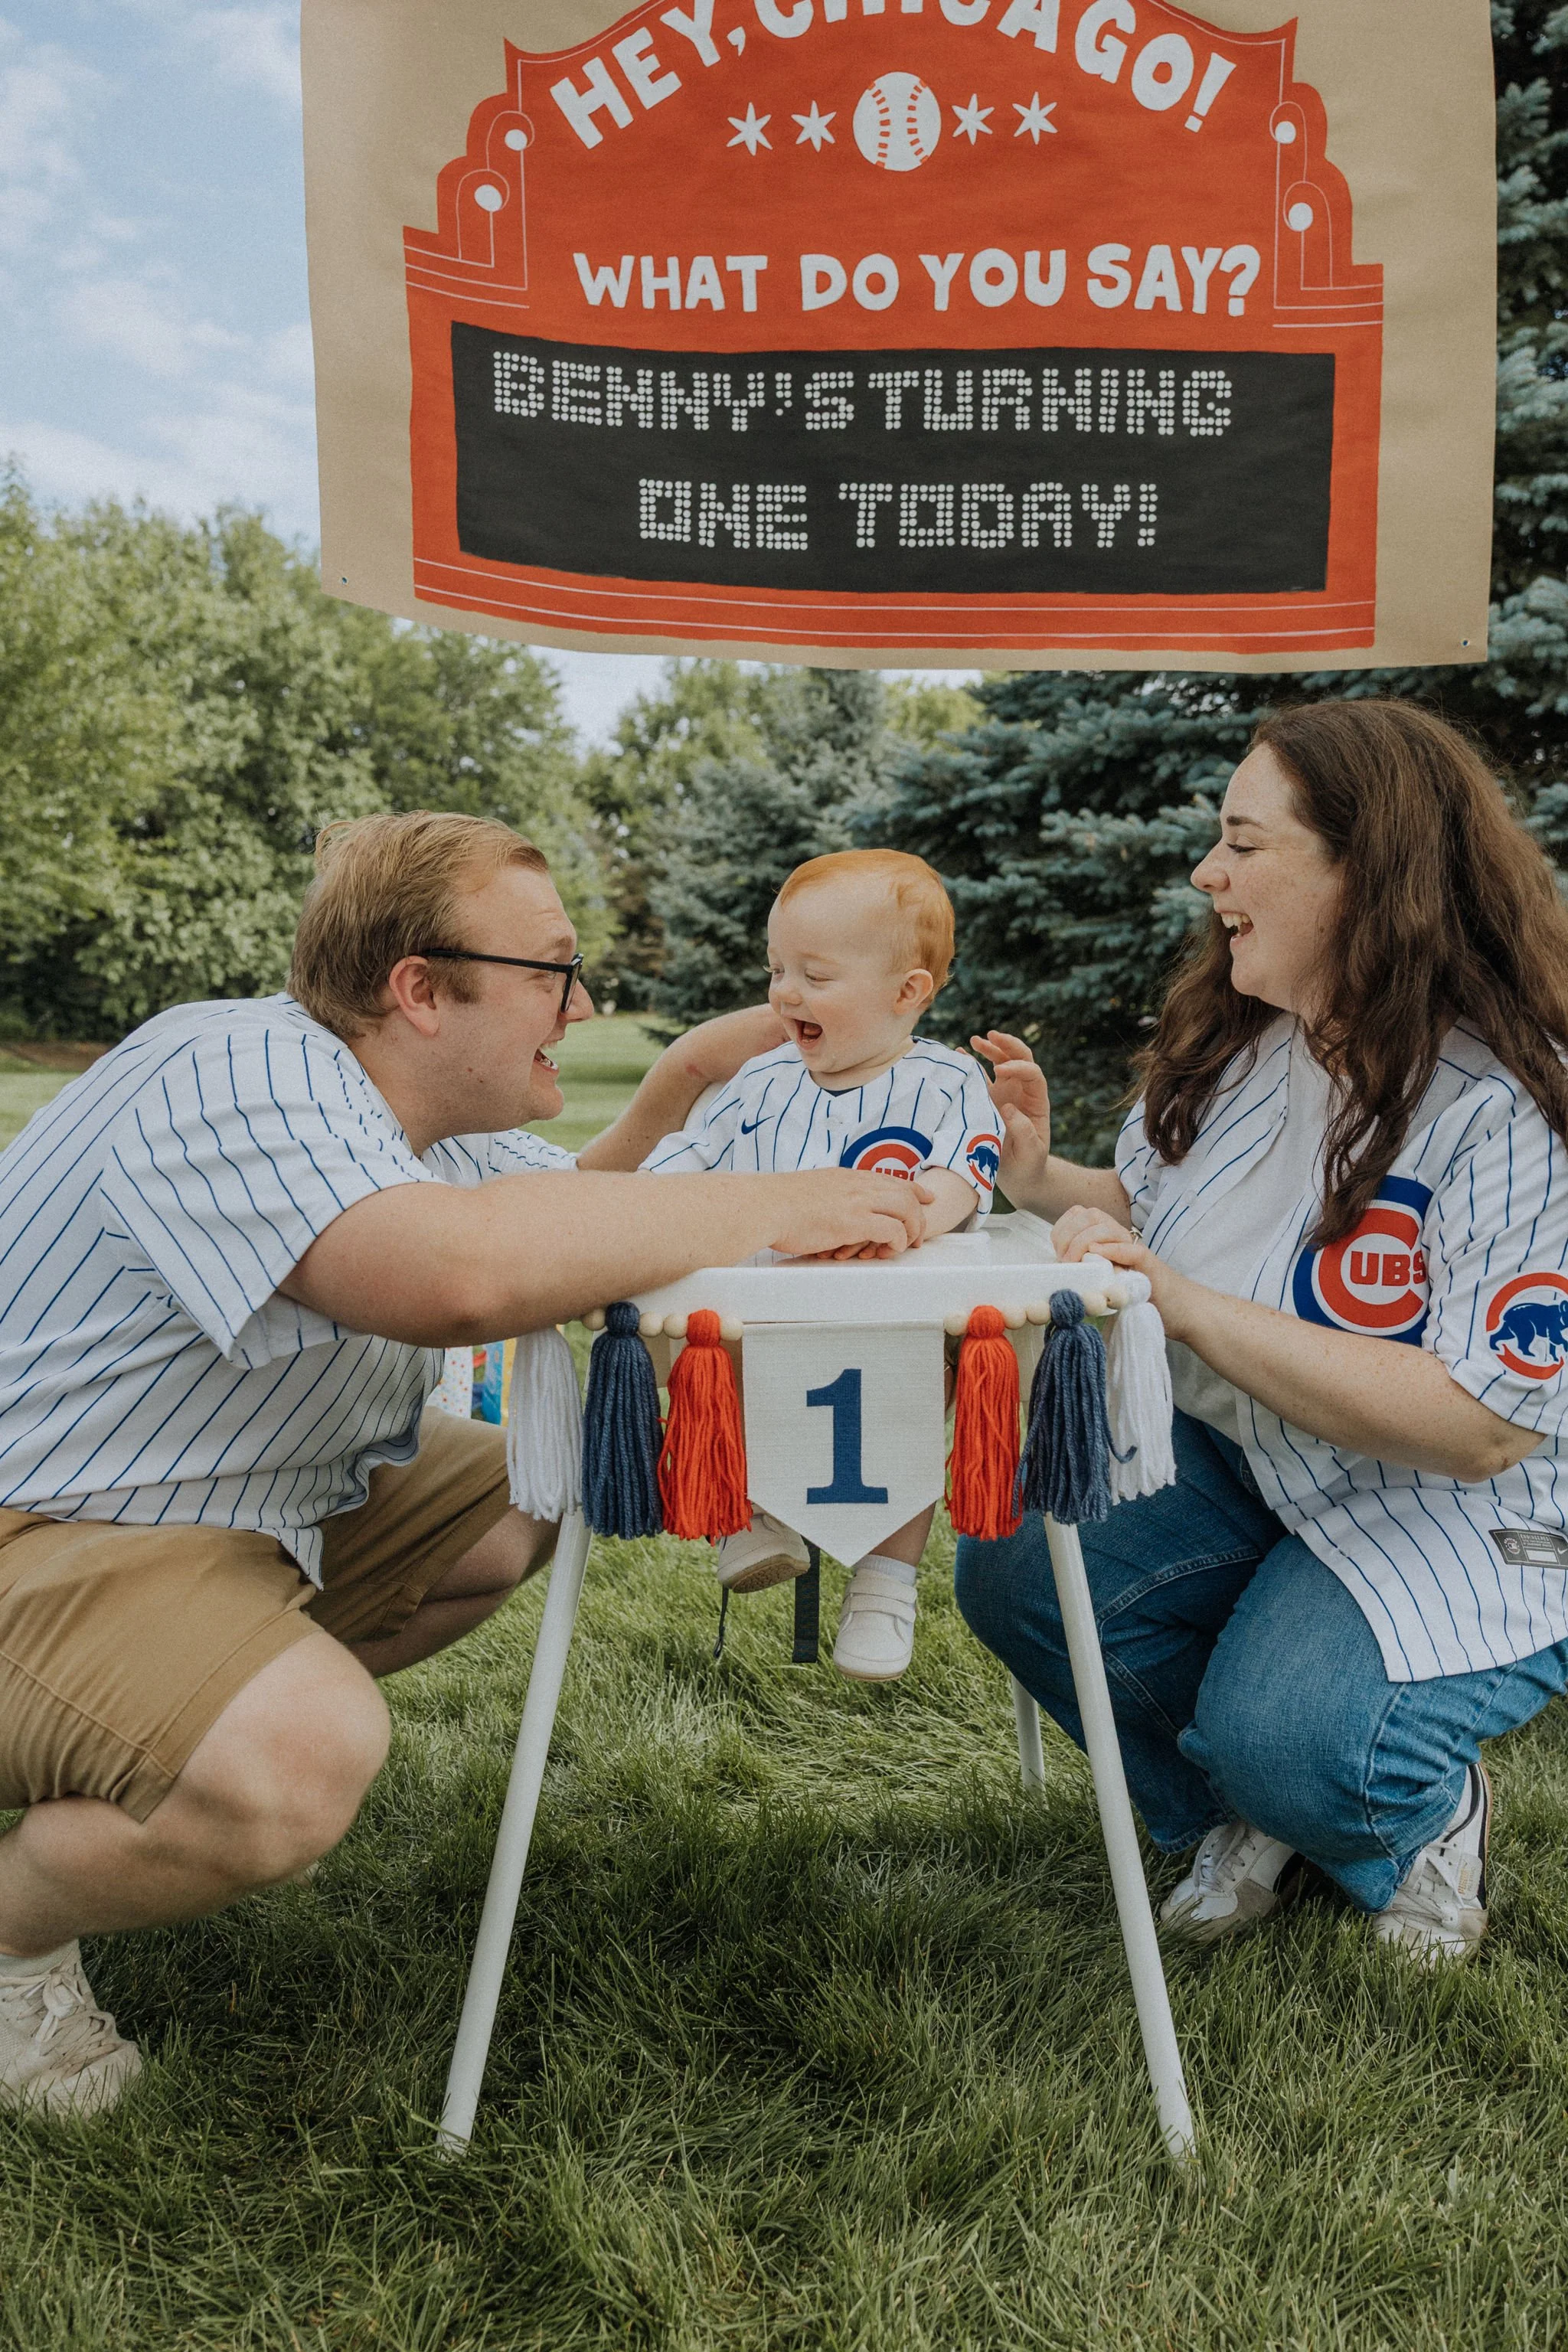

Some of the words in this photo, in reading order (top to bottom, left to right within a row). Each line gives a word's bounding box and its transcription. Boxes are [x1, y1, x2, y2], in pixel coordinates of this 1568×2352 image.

[550, 0, 746, 149] HEY,
[573, 253, 768, 312] WHAT
[800, 253, 900, 311] DO
[918, 248, 1067, 312] YOU
[1087, 243, 1260, 316] SAY?
[639, 479, 808, 550] ONE
[838, 482, 1158, 549] TODAY!
[806, 1368, 888, 1504] 1
